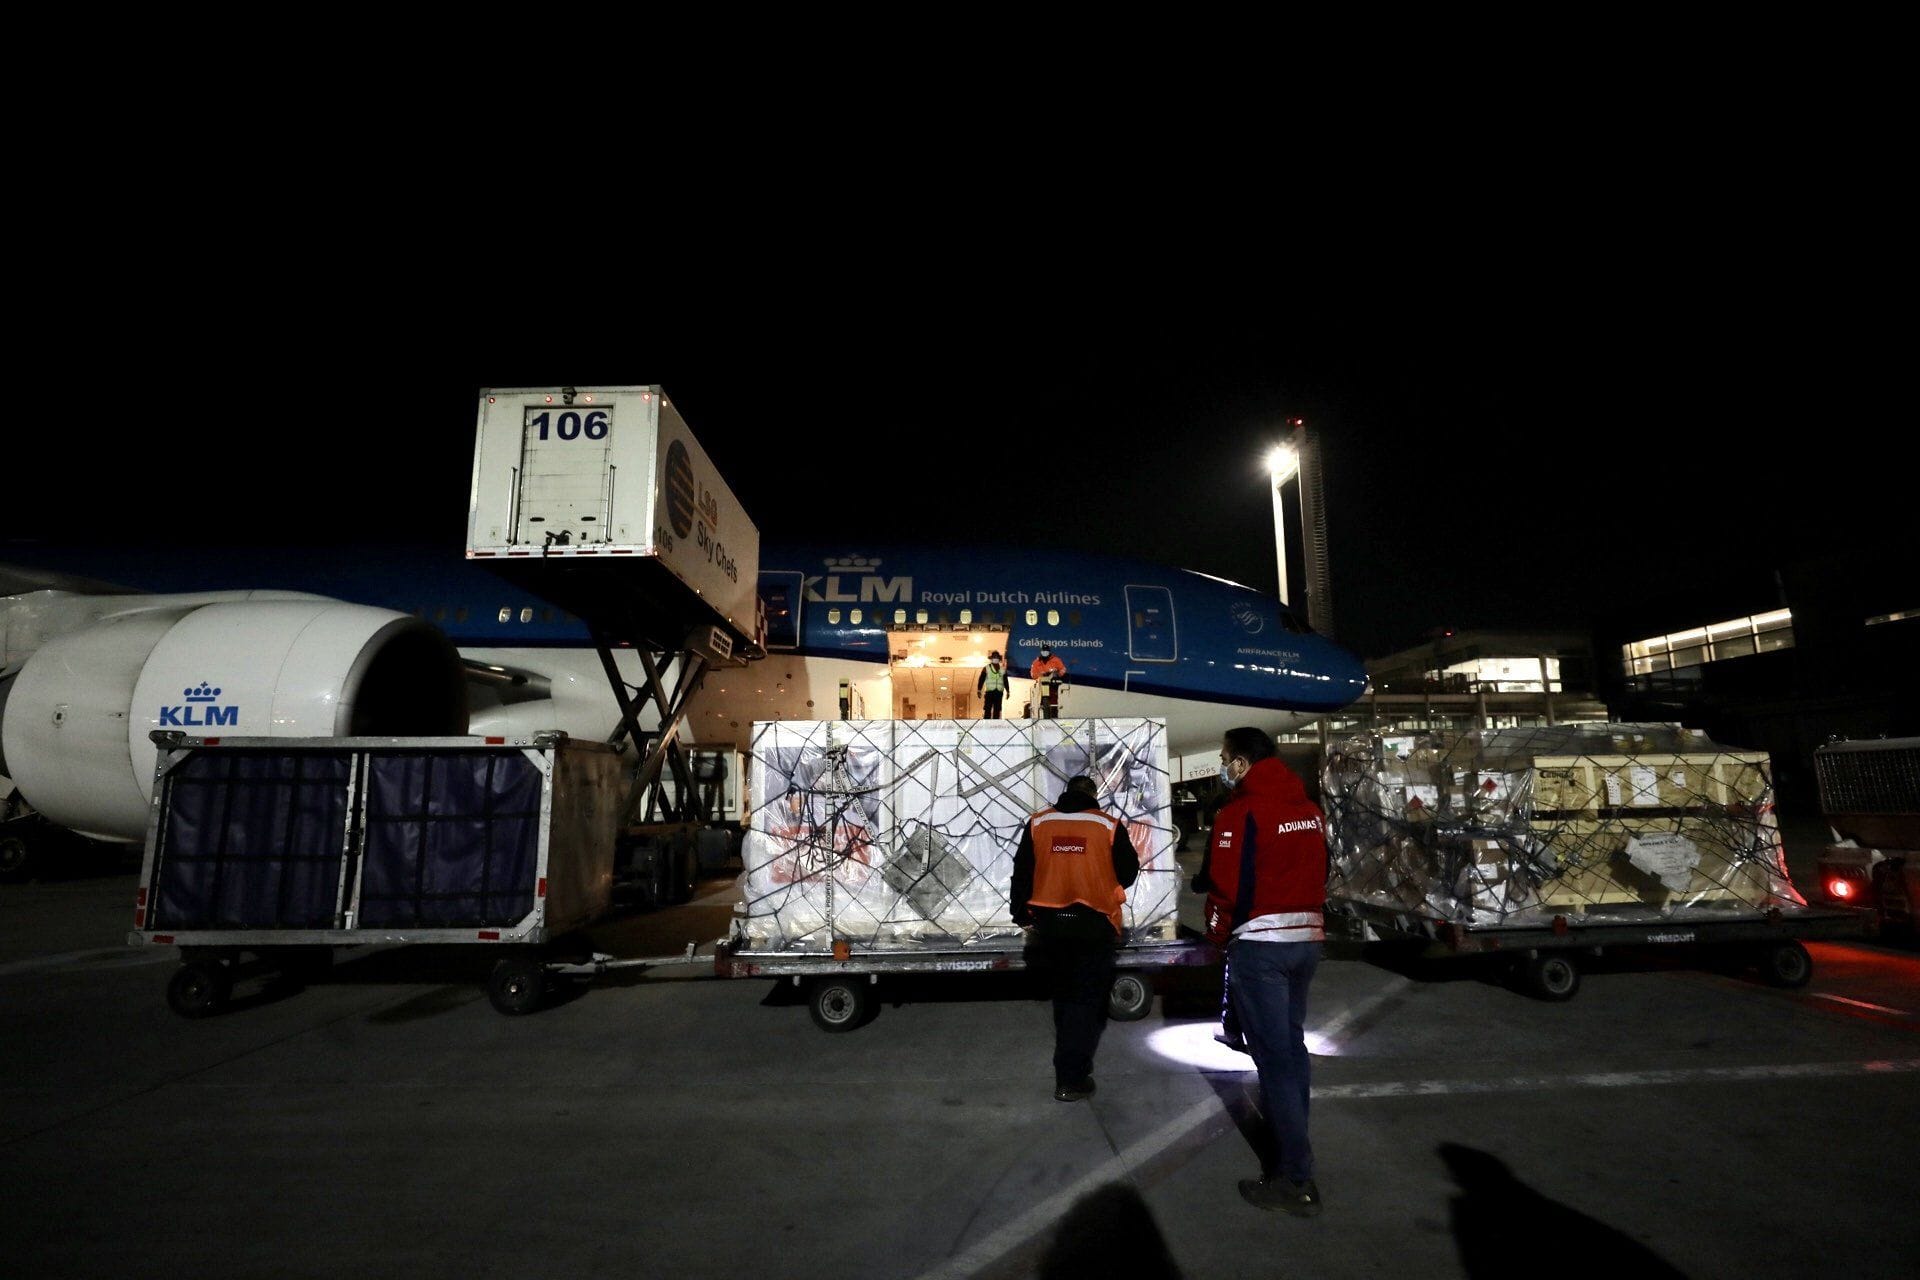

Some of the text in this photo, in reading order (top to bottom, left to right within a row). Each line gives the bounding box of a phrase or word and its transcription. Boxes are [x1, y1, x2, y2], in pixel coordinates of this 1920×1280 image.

[532, 411, 609, 440] 106
[697, 520, 738, 584] Sky Chefs
[921, 589, 1101, 606] Royal Dutch Airlines
[1070, 638, 1104, 648] Islands
[159, 705, 239, 727] KLM
[1278, 819, 1317, 834] ADUANAS
[1647, 931, 1697, 944] swissport
[936, 960, 994, 972] swissport
